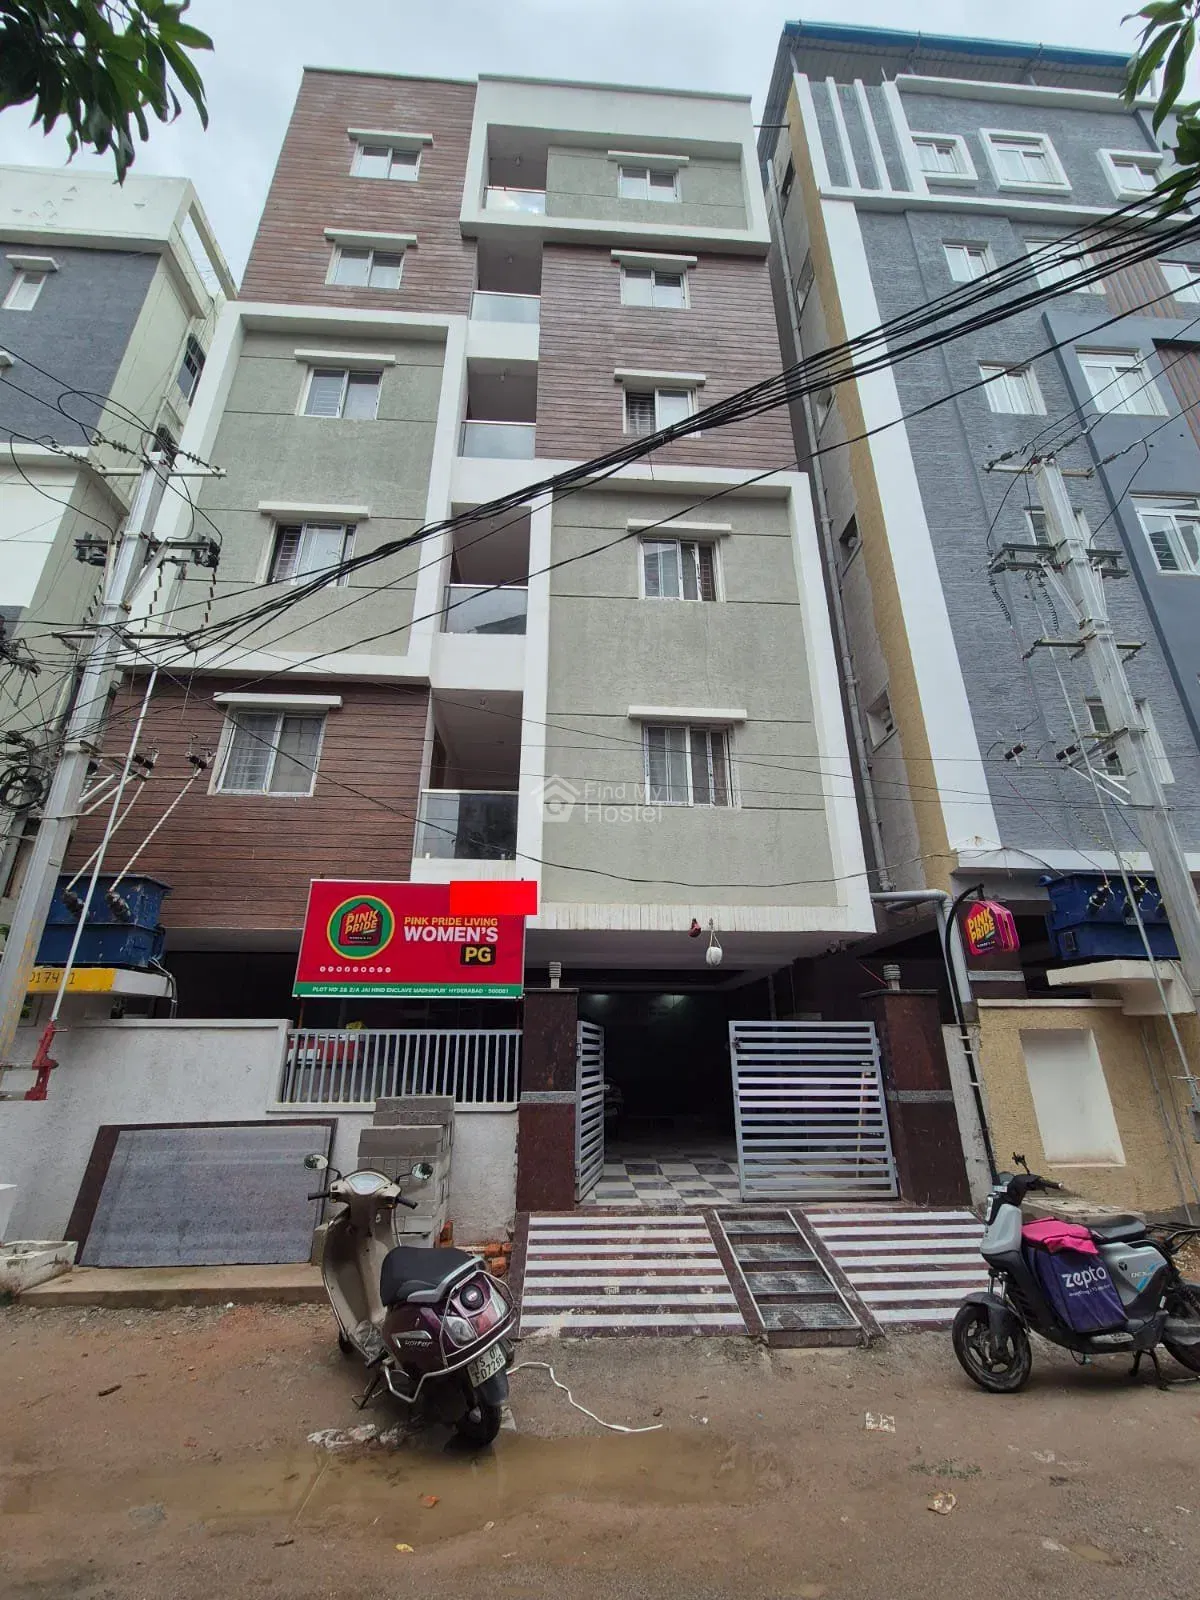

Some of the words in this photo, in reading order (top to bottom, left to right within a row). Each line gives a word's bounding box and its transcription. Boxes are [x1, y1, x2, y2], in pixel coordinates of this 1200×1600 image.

[346, 910, 379, 926] PINK
[404, 917, 429, 925] PINK
[431, 917, 462, 926] PRIDE
[464, 918, 498, 926] LIVING
[967, 907, 994, 930] PINK
[344, 919, 378, 935] PRIDE
[404, 926, 499, 942] WOMEN'S
[968, 919, 996, 944] PRIDE
[464, 946, 492, 963] PG
[1061, 1266, 1106, 1288] zepto
